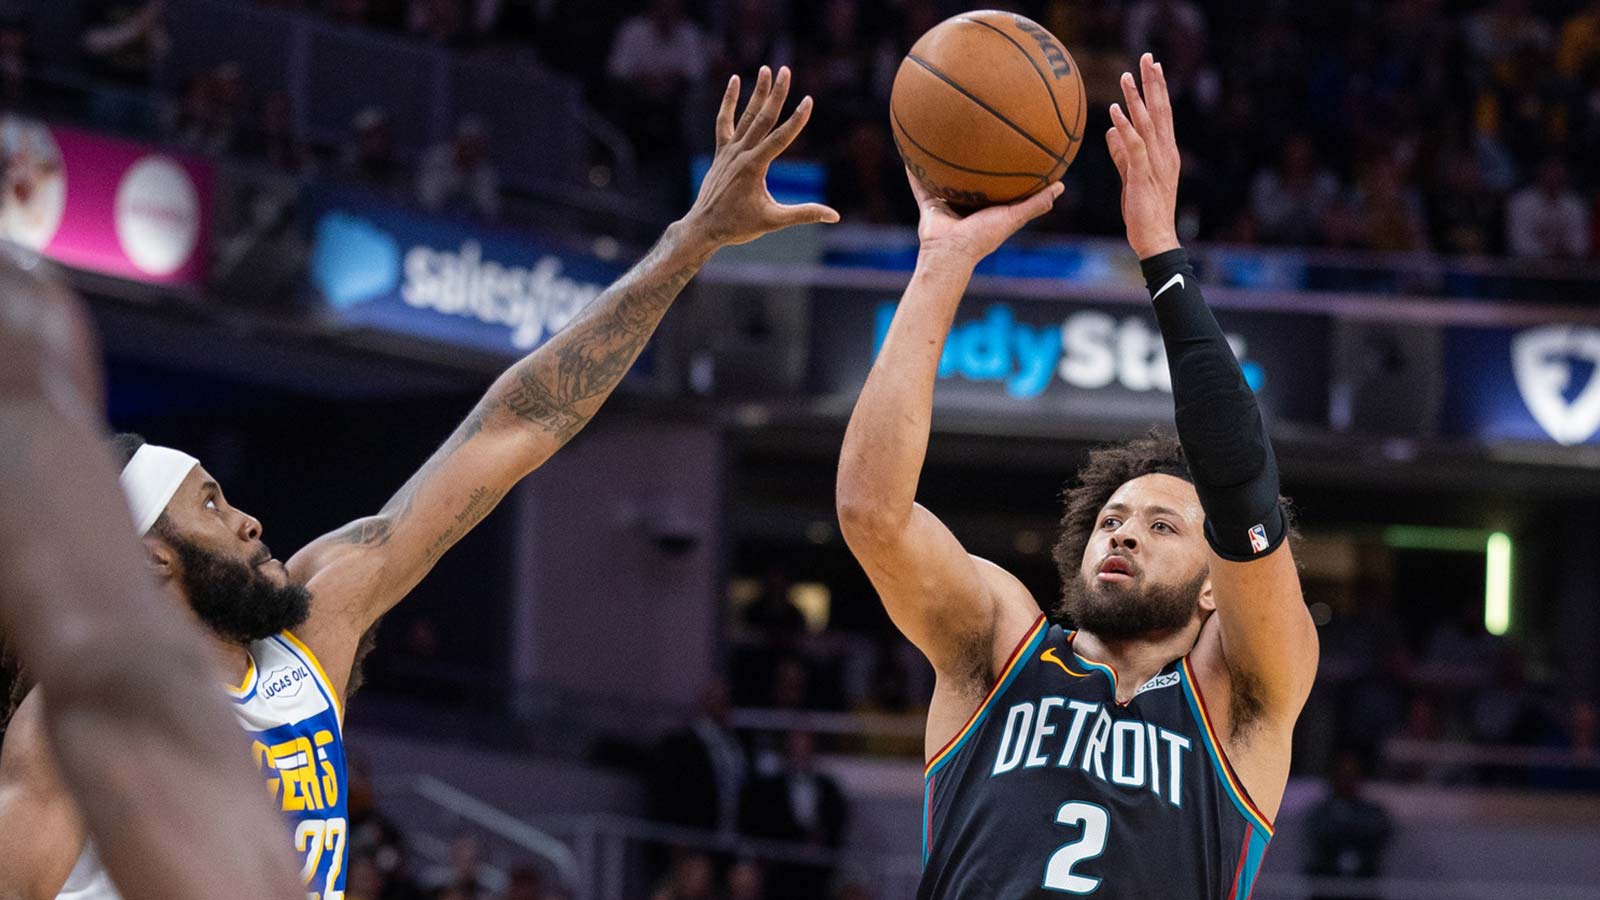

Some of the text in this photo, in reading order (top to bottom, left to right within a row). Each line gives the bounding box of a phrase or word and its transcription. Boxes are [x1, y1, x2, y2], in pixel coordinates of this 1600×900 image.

[291, 666, 308, 681] OIL
[992, 697, 1191, 808] DETROIT
[295, 817, 346, 900] 22
[1041, 800, 1110, 895] 2
